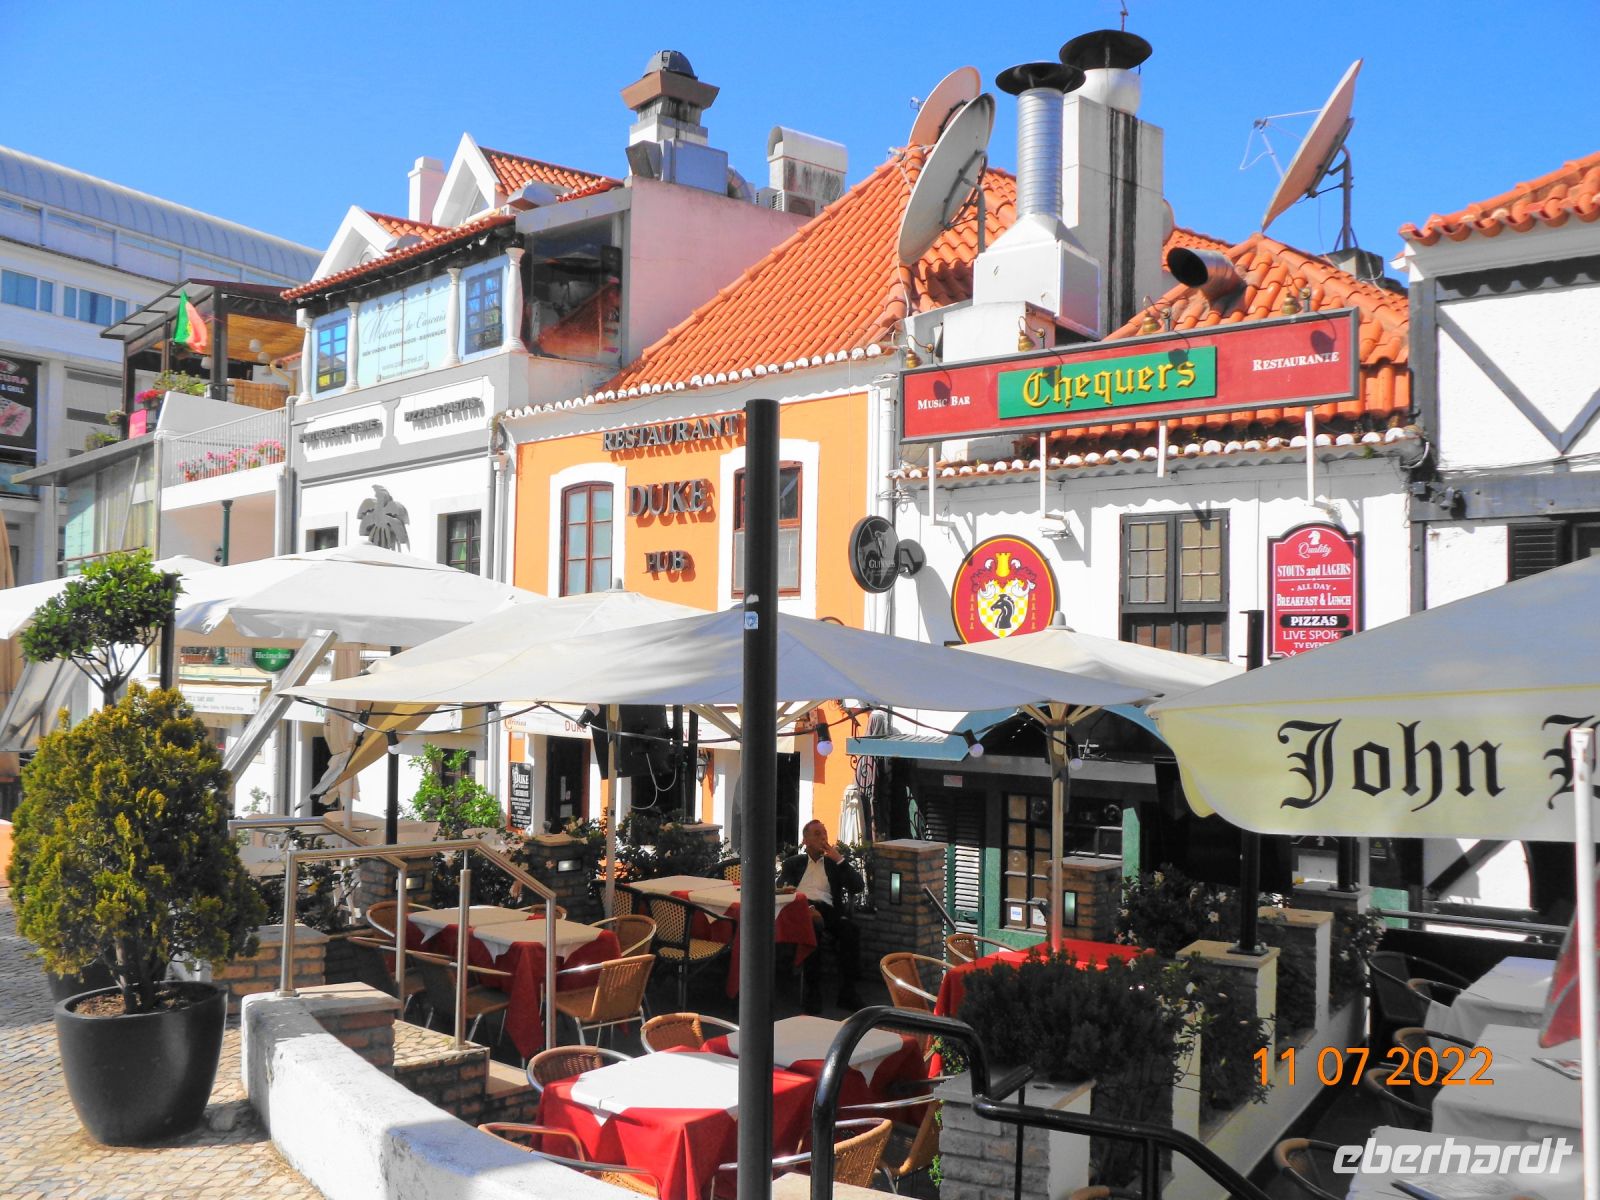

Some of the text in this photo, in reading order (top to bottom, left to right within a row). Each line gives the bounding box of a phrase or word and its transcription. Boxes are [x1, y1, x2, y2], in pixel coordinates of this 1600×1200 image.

[1252, 352, 1340, 371] RESTAURANTE
[1023, 361, 1196, 408] Chequers
[918, 396, 970, 410] MUSIC BAR
[602, 413, 739, 452] RESTAURANT
[627, 478, 707, 517] DUKE
[1296, 542, 1332, 558] Quality
[643, 550, 686, 574] PUB
[1277, 563, 1351, 576] STOUTS and LAGERS
[1313, 583, 1332, 591] DAY
[1319, 593, 1326, 606] &
[1290, 616, 1338, 627] PIZZAS
[1283, 630, 1339, 640] LIVE SPOR
[1277, 718, 1506, 812] John
